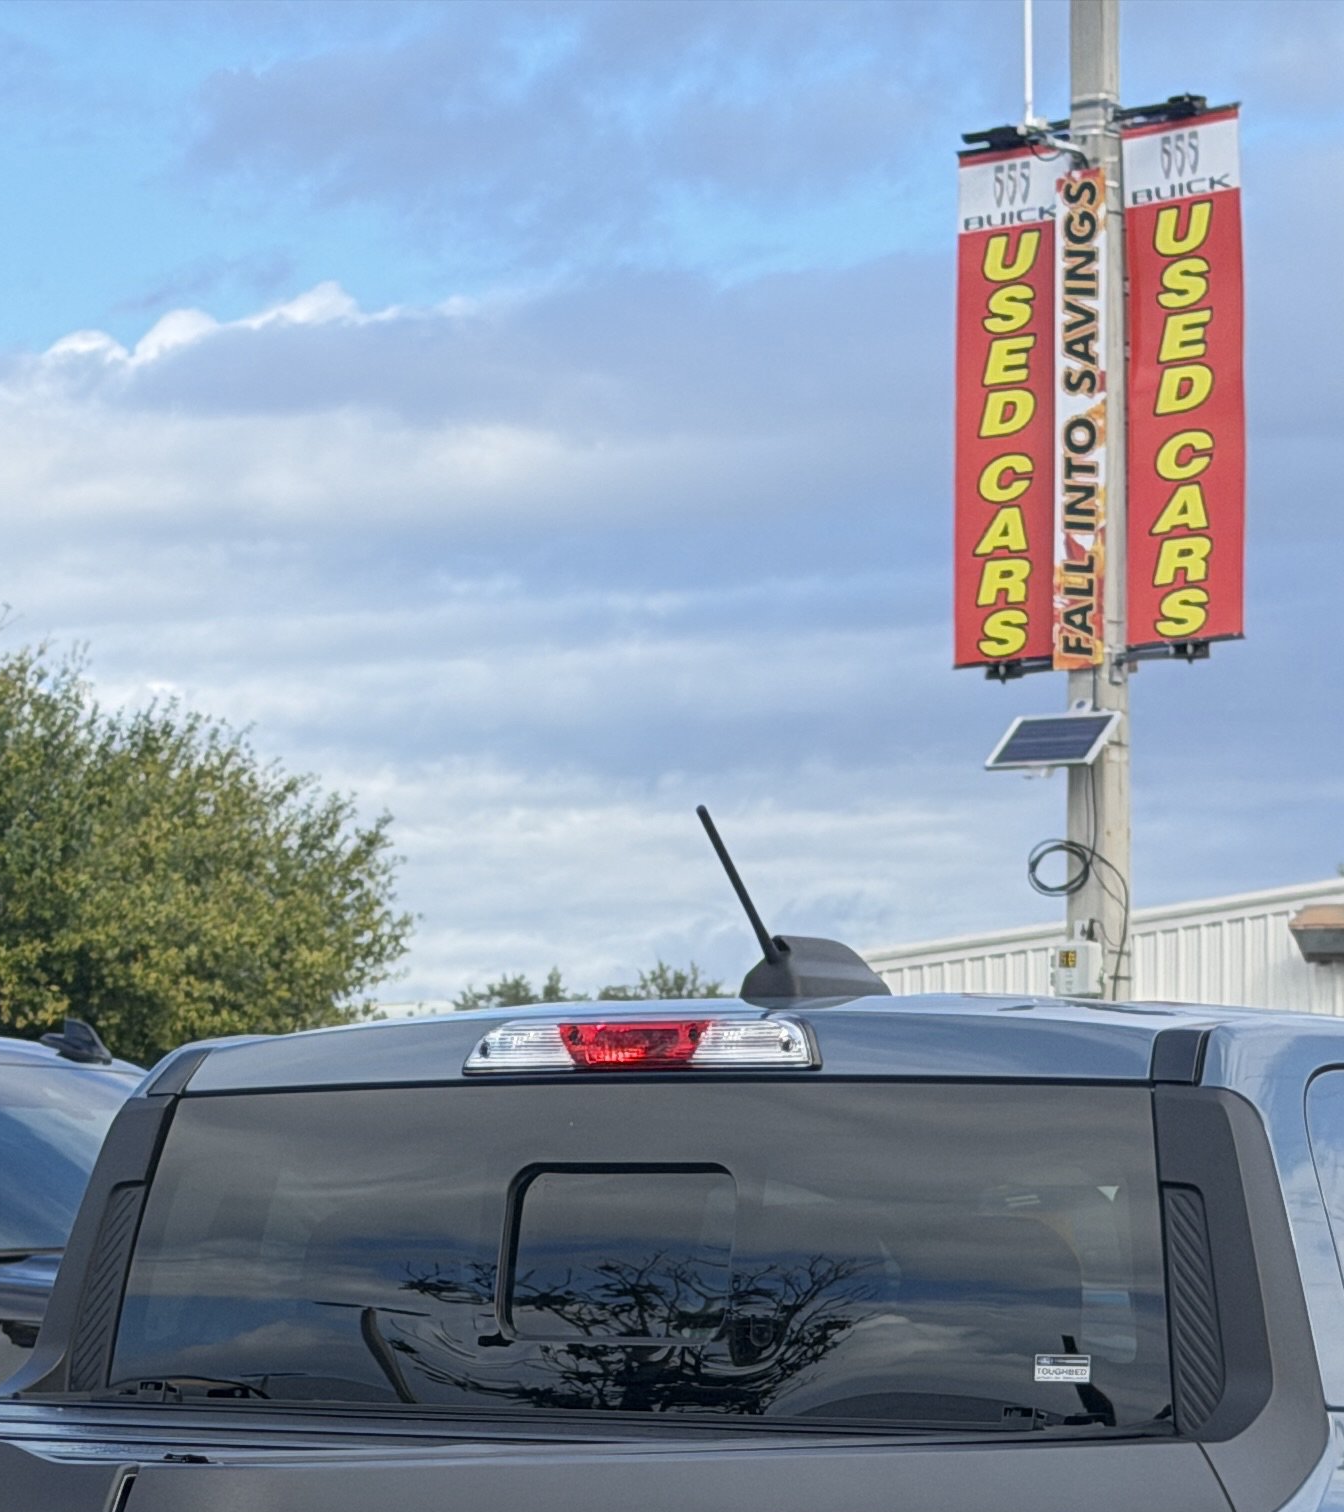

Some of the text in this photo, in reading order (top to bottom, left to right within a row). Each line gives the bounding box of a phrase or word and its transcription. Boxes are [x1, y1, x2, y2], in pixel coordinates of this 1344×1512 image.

[1132, 173, 1232, 206] BUICK
[973, 229, 1040, 658] USED CARS
[1062, 178, 1099, 657] FALL INTO SAVINGS
[1150, 201, 1214, 639] USED CARS
